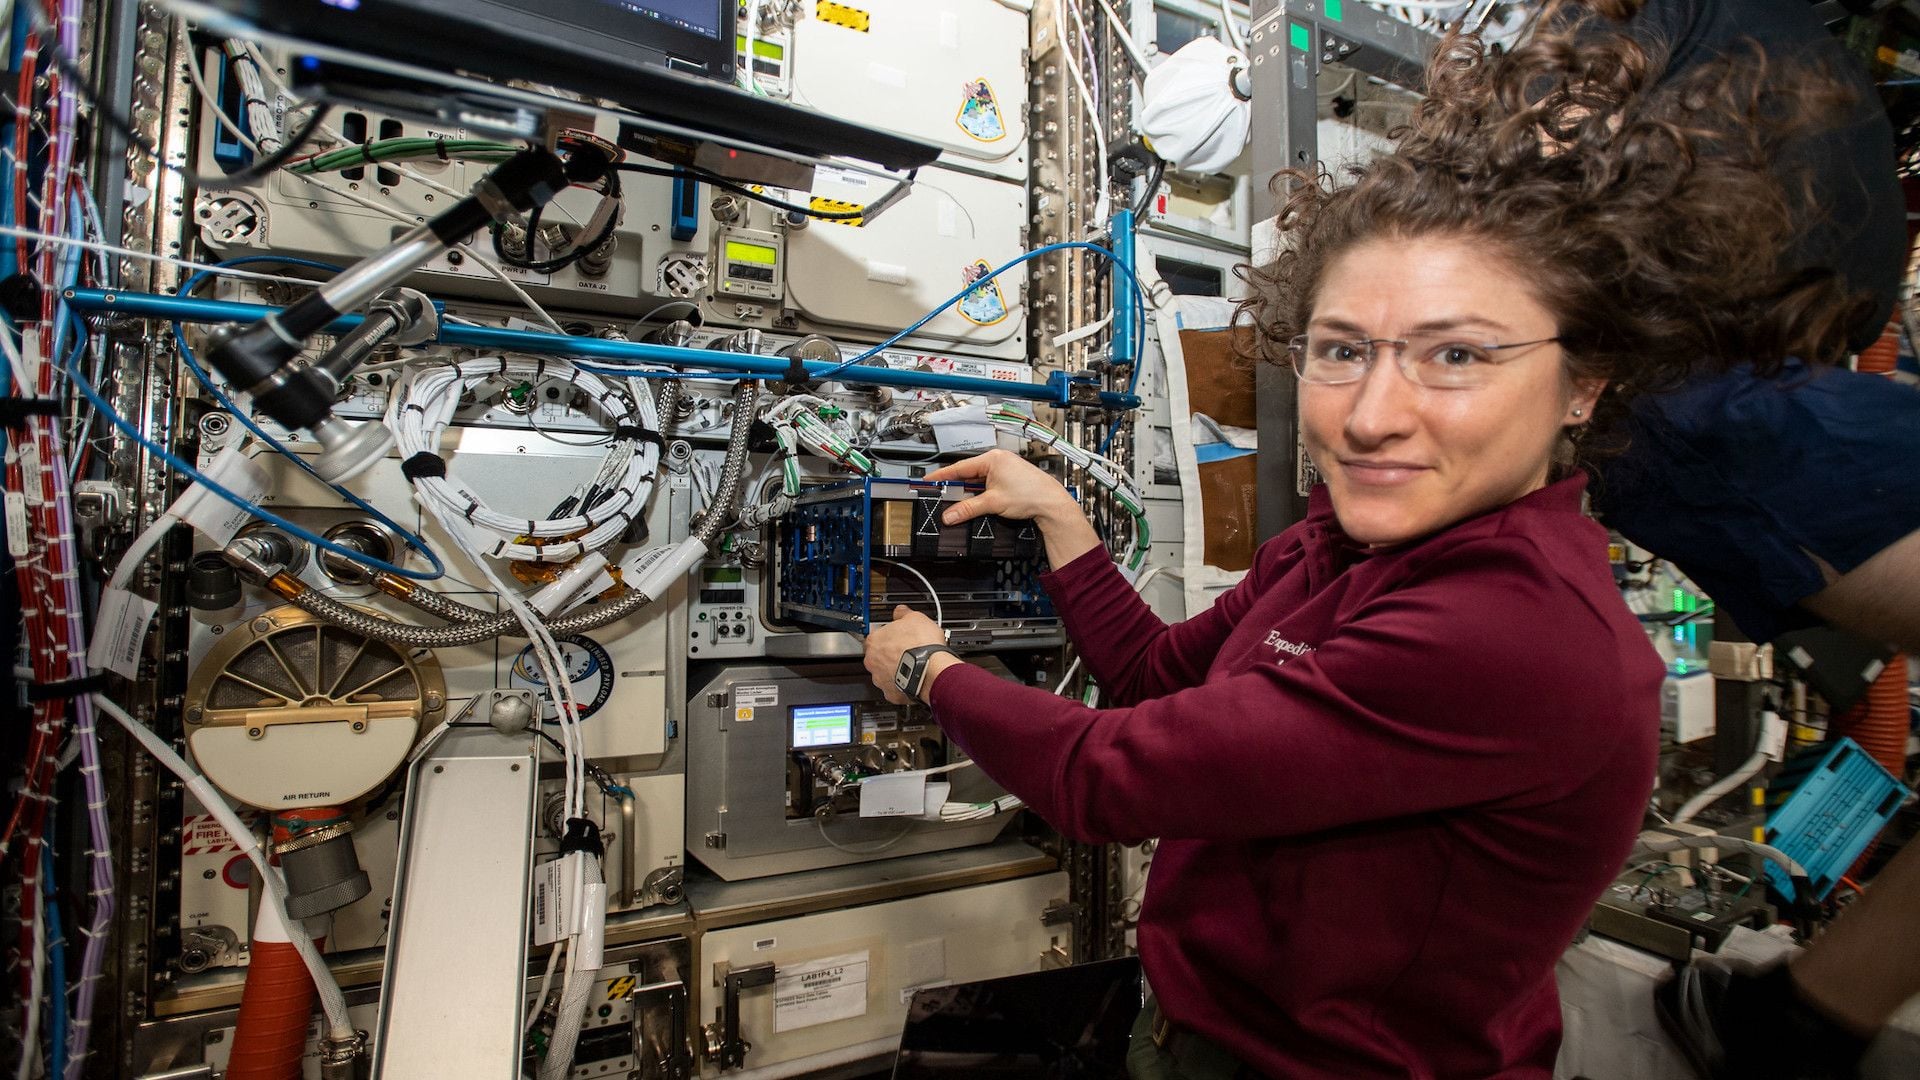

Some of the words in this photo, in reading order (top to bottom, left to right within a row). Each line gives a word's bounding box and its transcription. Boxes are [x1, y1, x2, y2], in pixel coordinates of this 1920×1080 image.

[685, 253, 704, 261] OPEN
[578, 281, 597, 289] DATA
[1264, 630, 1317, 656] Expedi
[597, 672, 612, 704] PAYLOAD
[298, 791, 331, 800] RETURN
[196, 831, 221, 839] FIRE
